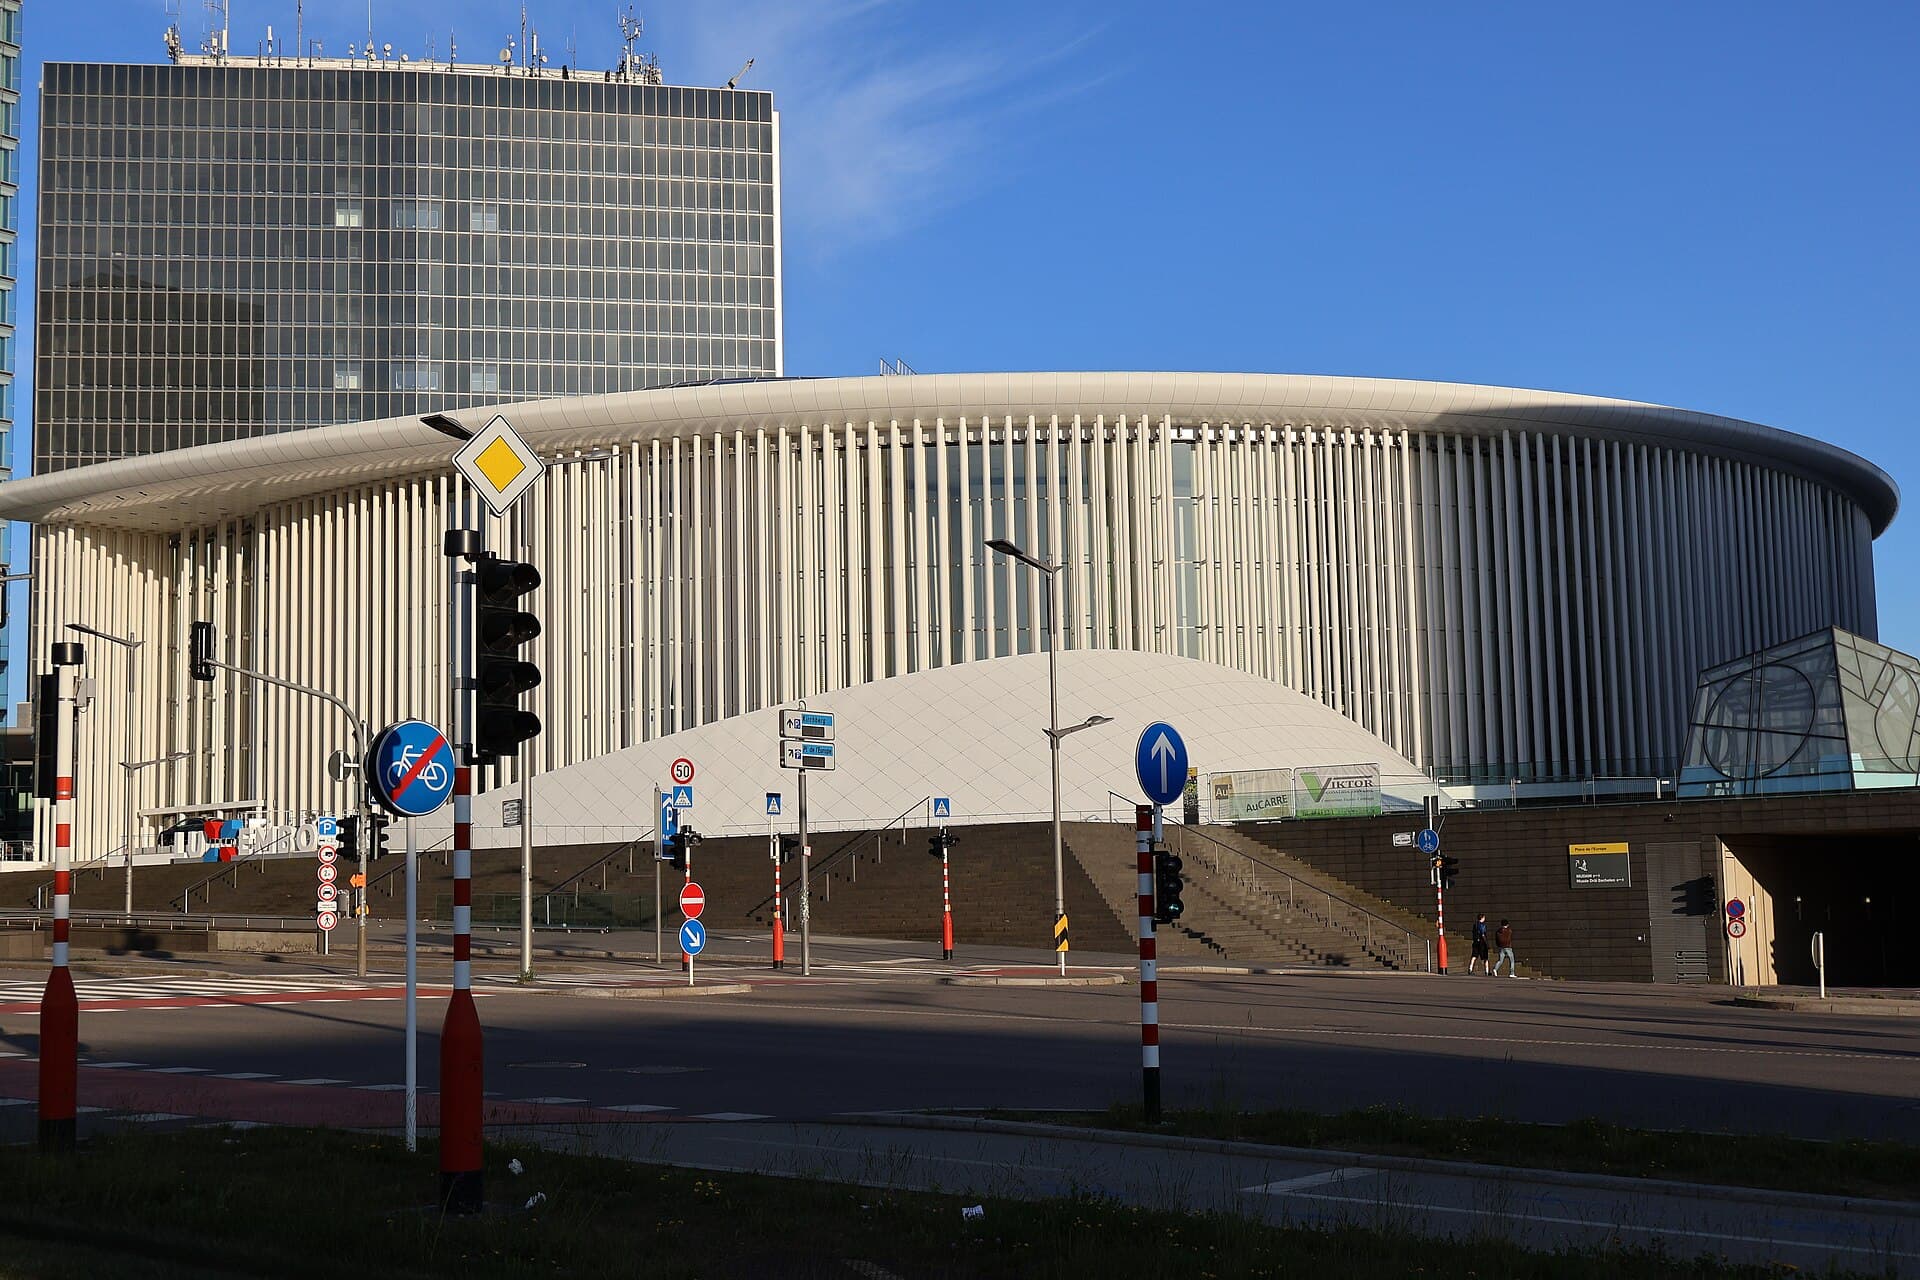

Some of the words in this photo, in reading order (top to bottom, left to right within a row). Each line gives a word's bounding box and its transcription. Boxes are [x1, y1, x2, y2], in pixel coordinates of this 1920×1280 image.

[676, 765, 690, 778] 50
[1299, 771, 1374, 803] VIKTOR
[1246, 794, 1289, 813] AuCARRE
